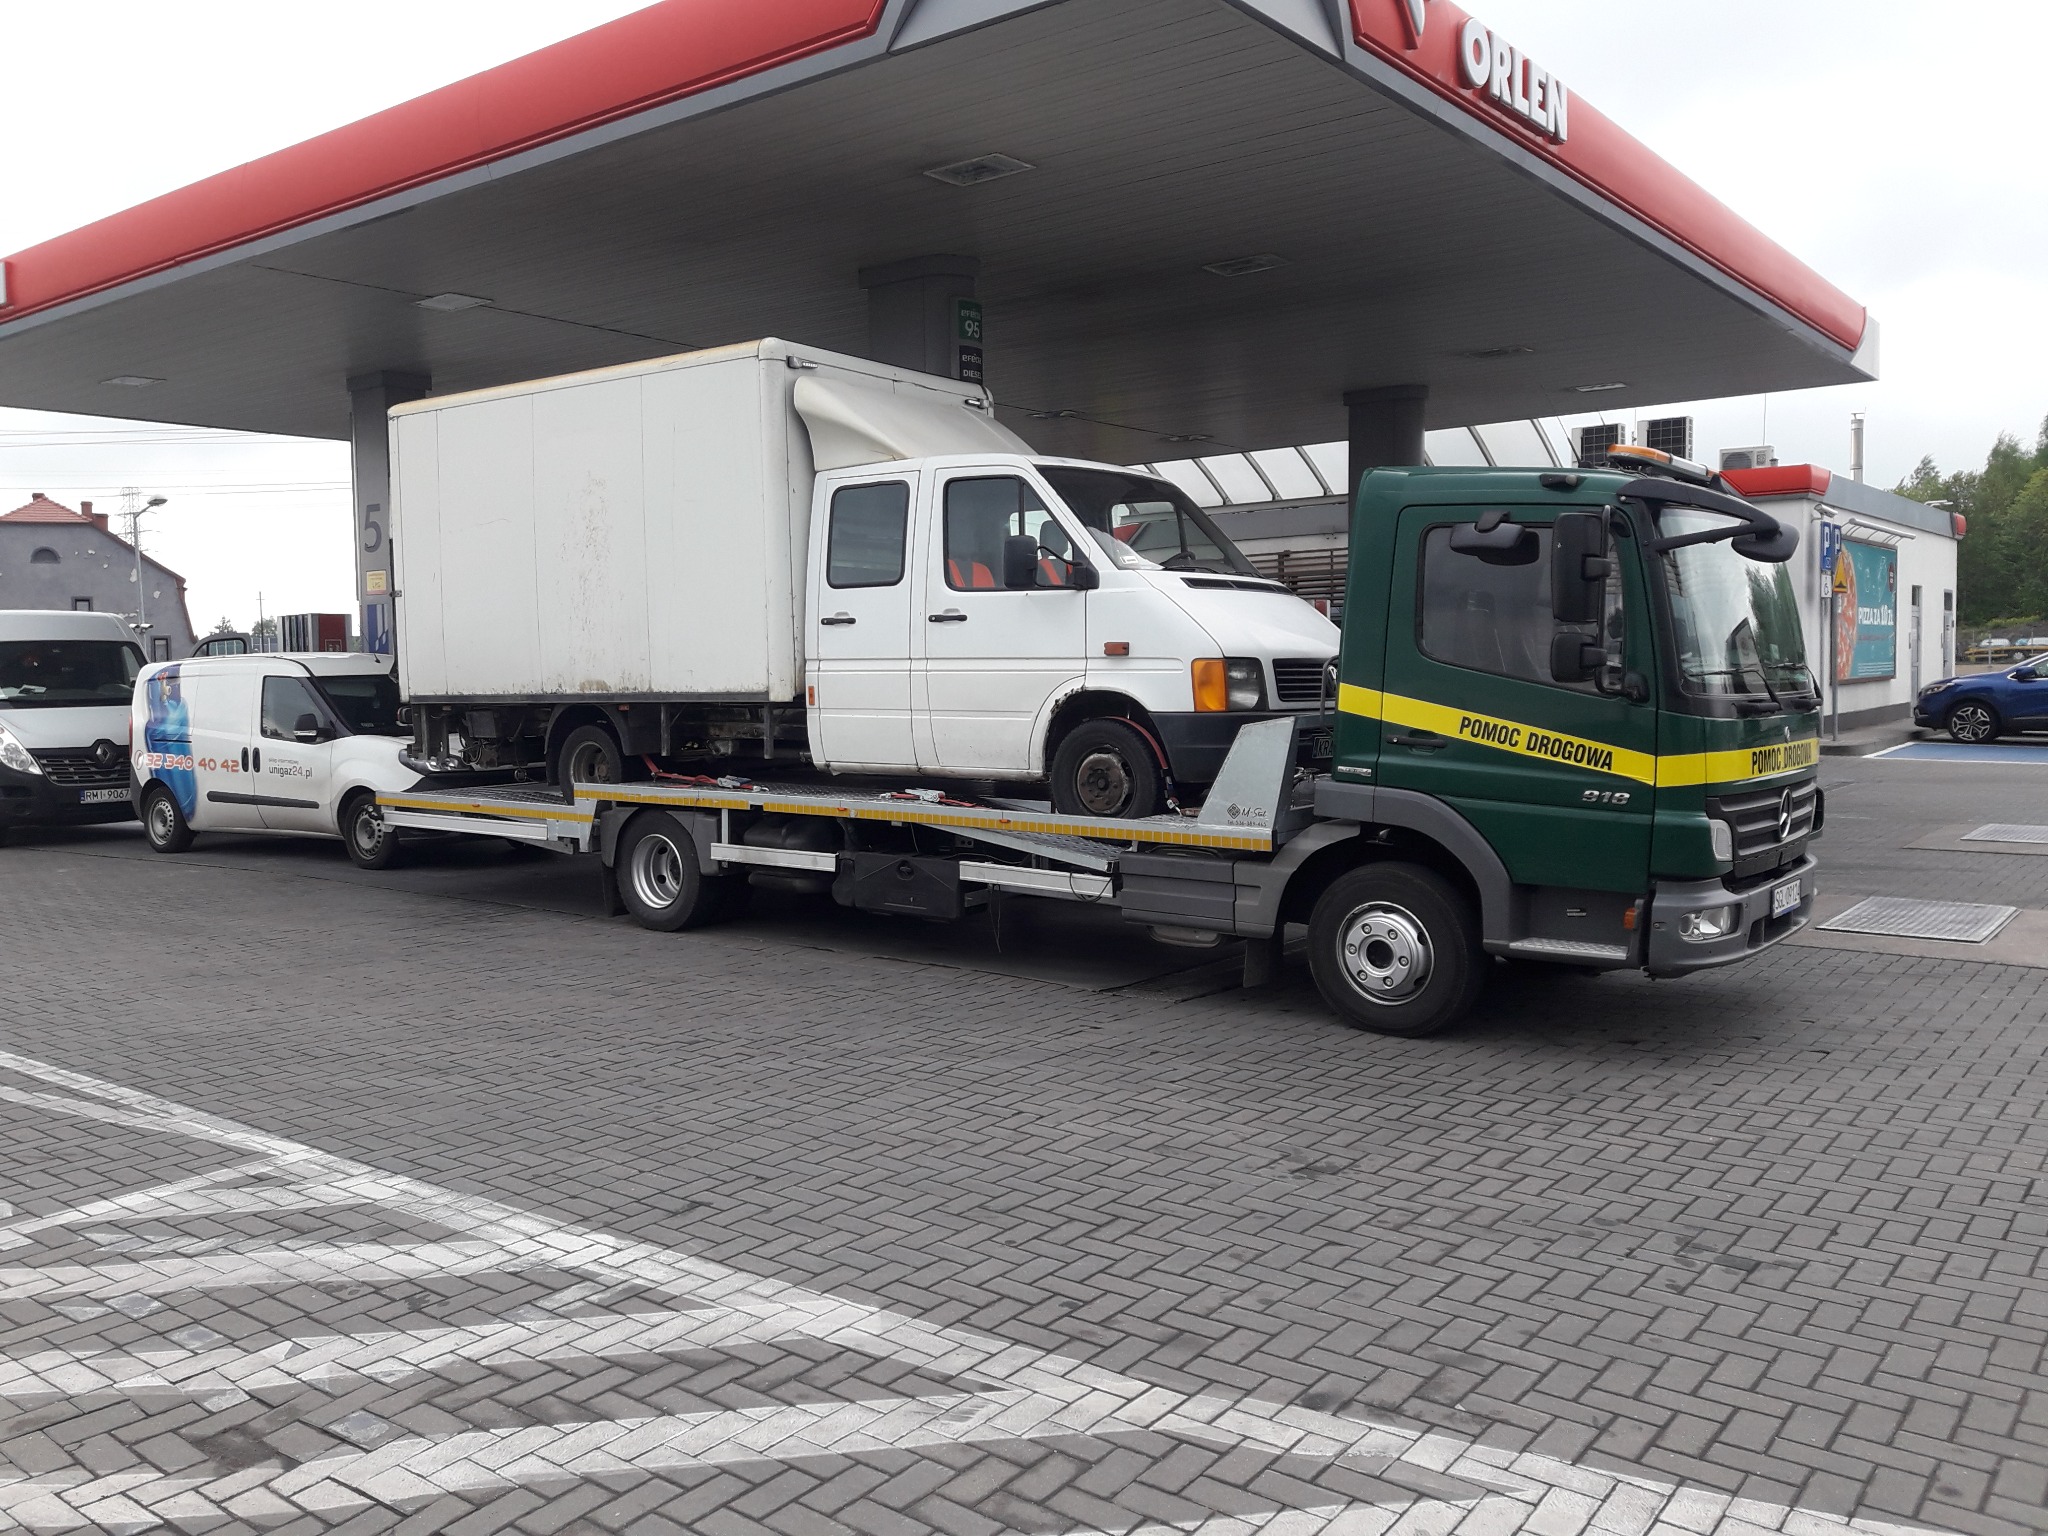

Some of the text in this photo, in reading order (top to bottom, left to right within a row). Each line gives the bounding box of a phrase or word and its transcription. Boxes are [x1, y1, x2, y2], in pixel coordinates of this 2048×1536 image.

[1461, 17, 1568, 142] ORLEN
[964, 320, 980, 339] 95
[364, 503, 382, 553] 5
[1458, 716, 1614, 771] POMOC DROGOWA
[146, 753, 240, 773] 32 340 40 42
[1752, 742, 1812, 775] POMOC DROGOWA
[269, 764, 313, 779] unigaz24.pl
[85, 791, 103, 800] RMI
[1581, 790, 1630, 805] 918
